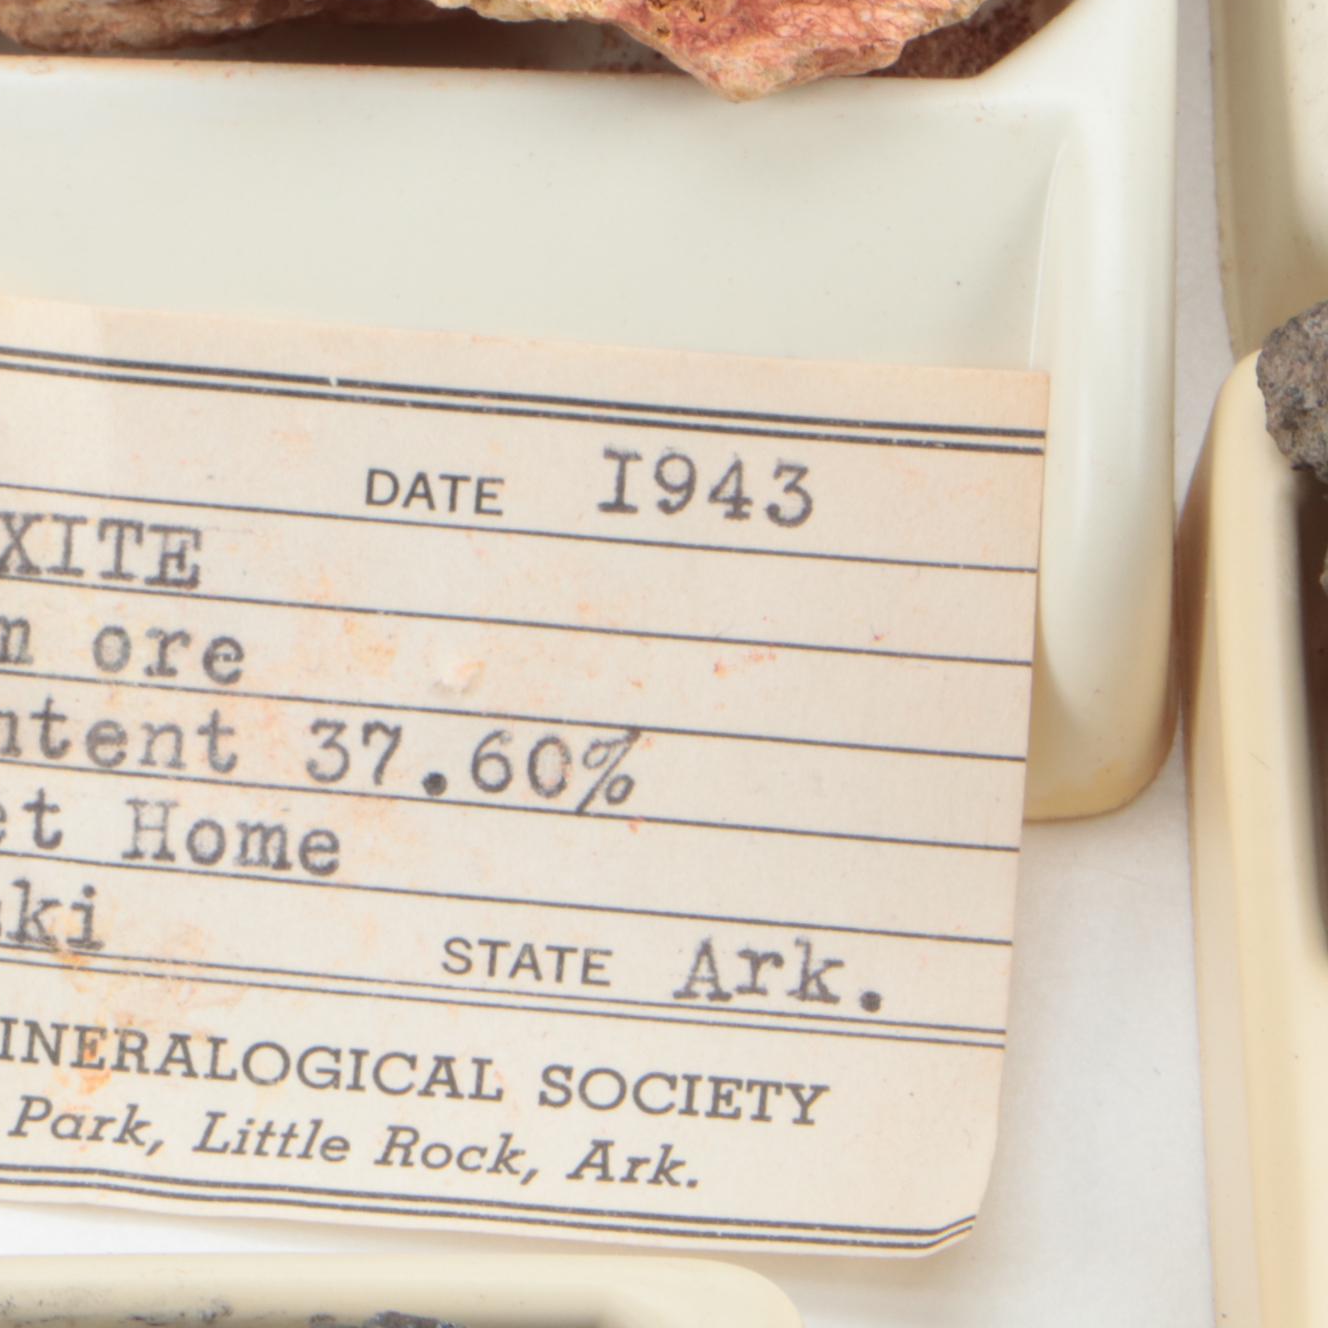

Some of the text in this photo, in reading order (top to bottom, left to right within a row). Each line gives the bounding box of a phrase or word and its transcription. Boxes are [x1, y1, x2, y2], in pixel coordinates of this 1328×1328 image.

[365, 468, 505, 516] DATE
[92, 621, 246, 684] ore
[306, 718, 641, 814] 37.60%
[122, 797, 342, 876] Home
[442, 936, 613, 987] STATE
[672, 938, 883, 1013] Ark.
[537, 1064, 830, 1126] SOCIETY
[8, 1095, 165, 1156] Park,
[192, 1109, 350, 1164] Little
[375, 1125, 539, 1184] Rock,
[567, 1139, 700, 1189] Ark.
